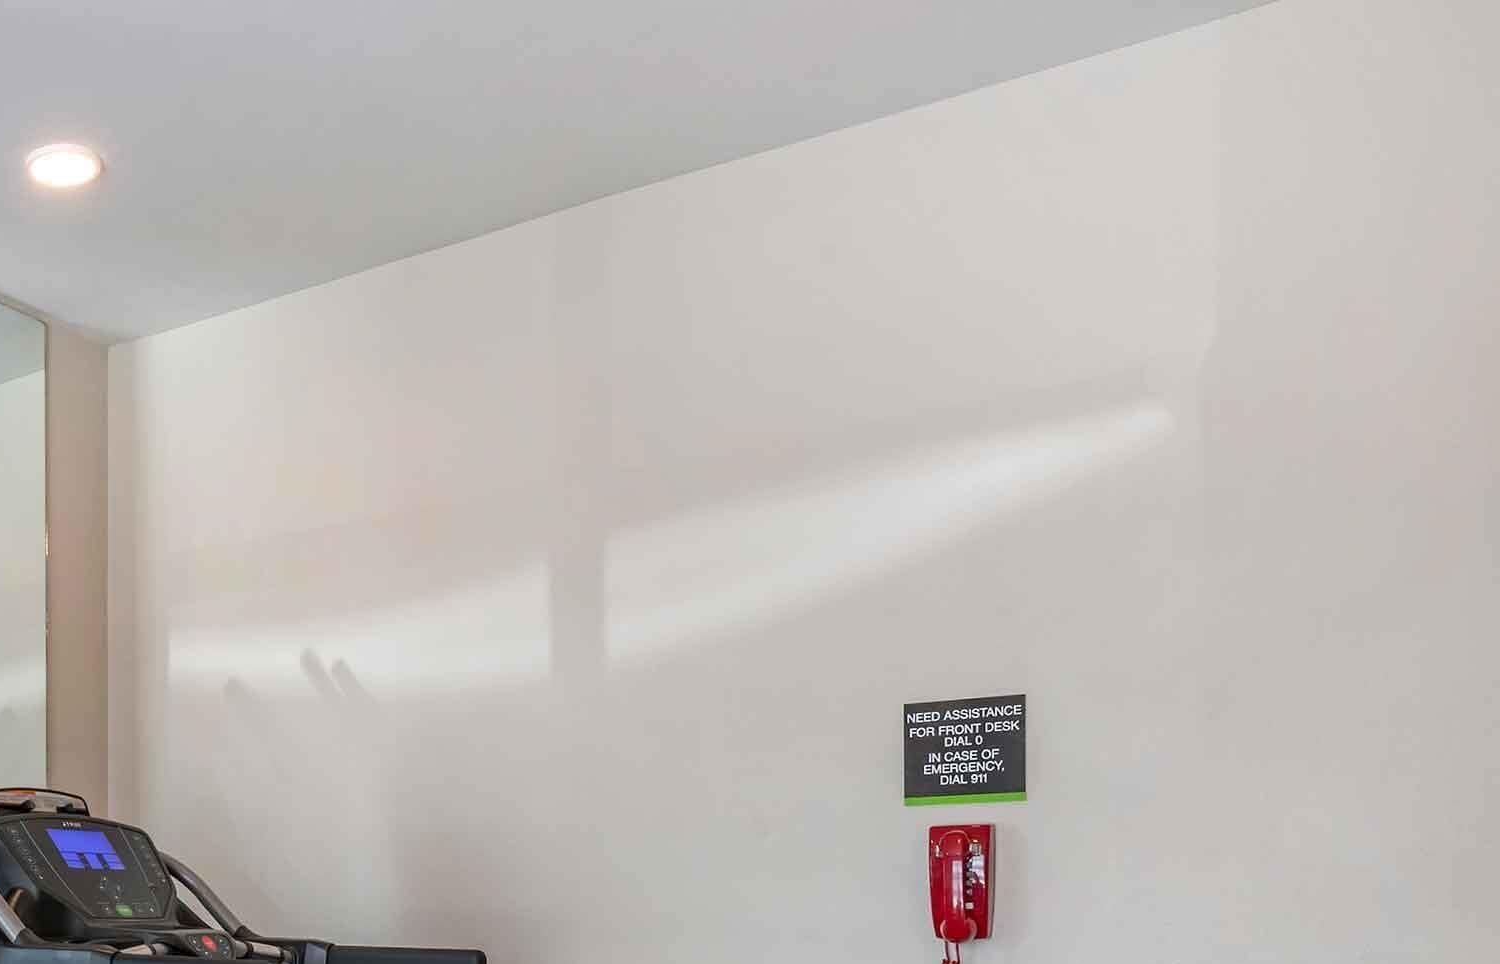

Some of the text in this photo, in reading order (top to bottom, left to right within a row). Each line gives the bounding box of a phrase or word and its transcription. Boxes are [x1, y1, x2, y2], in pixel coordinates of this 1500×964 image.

[906, 704, 1023, 724] NEED ASSISTANCE
[909, 719, 1020, 738] FOR FRONT DESK
[944, 735, 973, 748] DIAL
[928, 747, 1000, 763] IN CASE OF
[923, 759, 1006, 776] EMERGENCY,
[940, 773, 988, 786] DIAL 911
